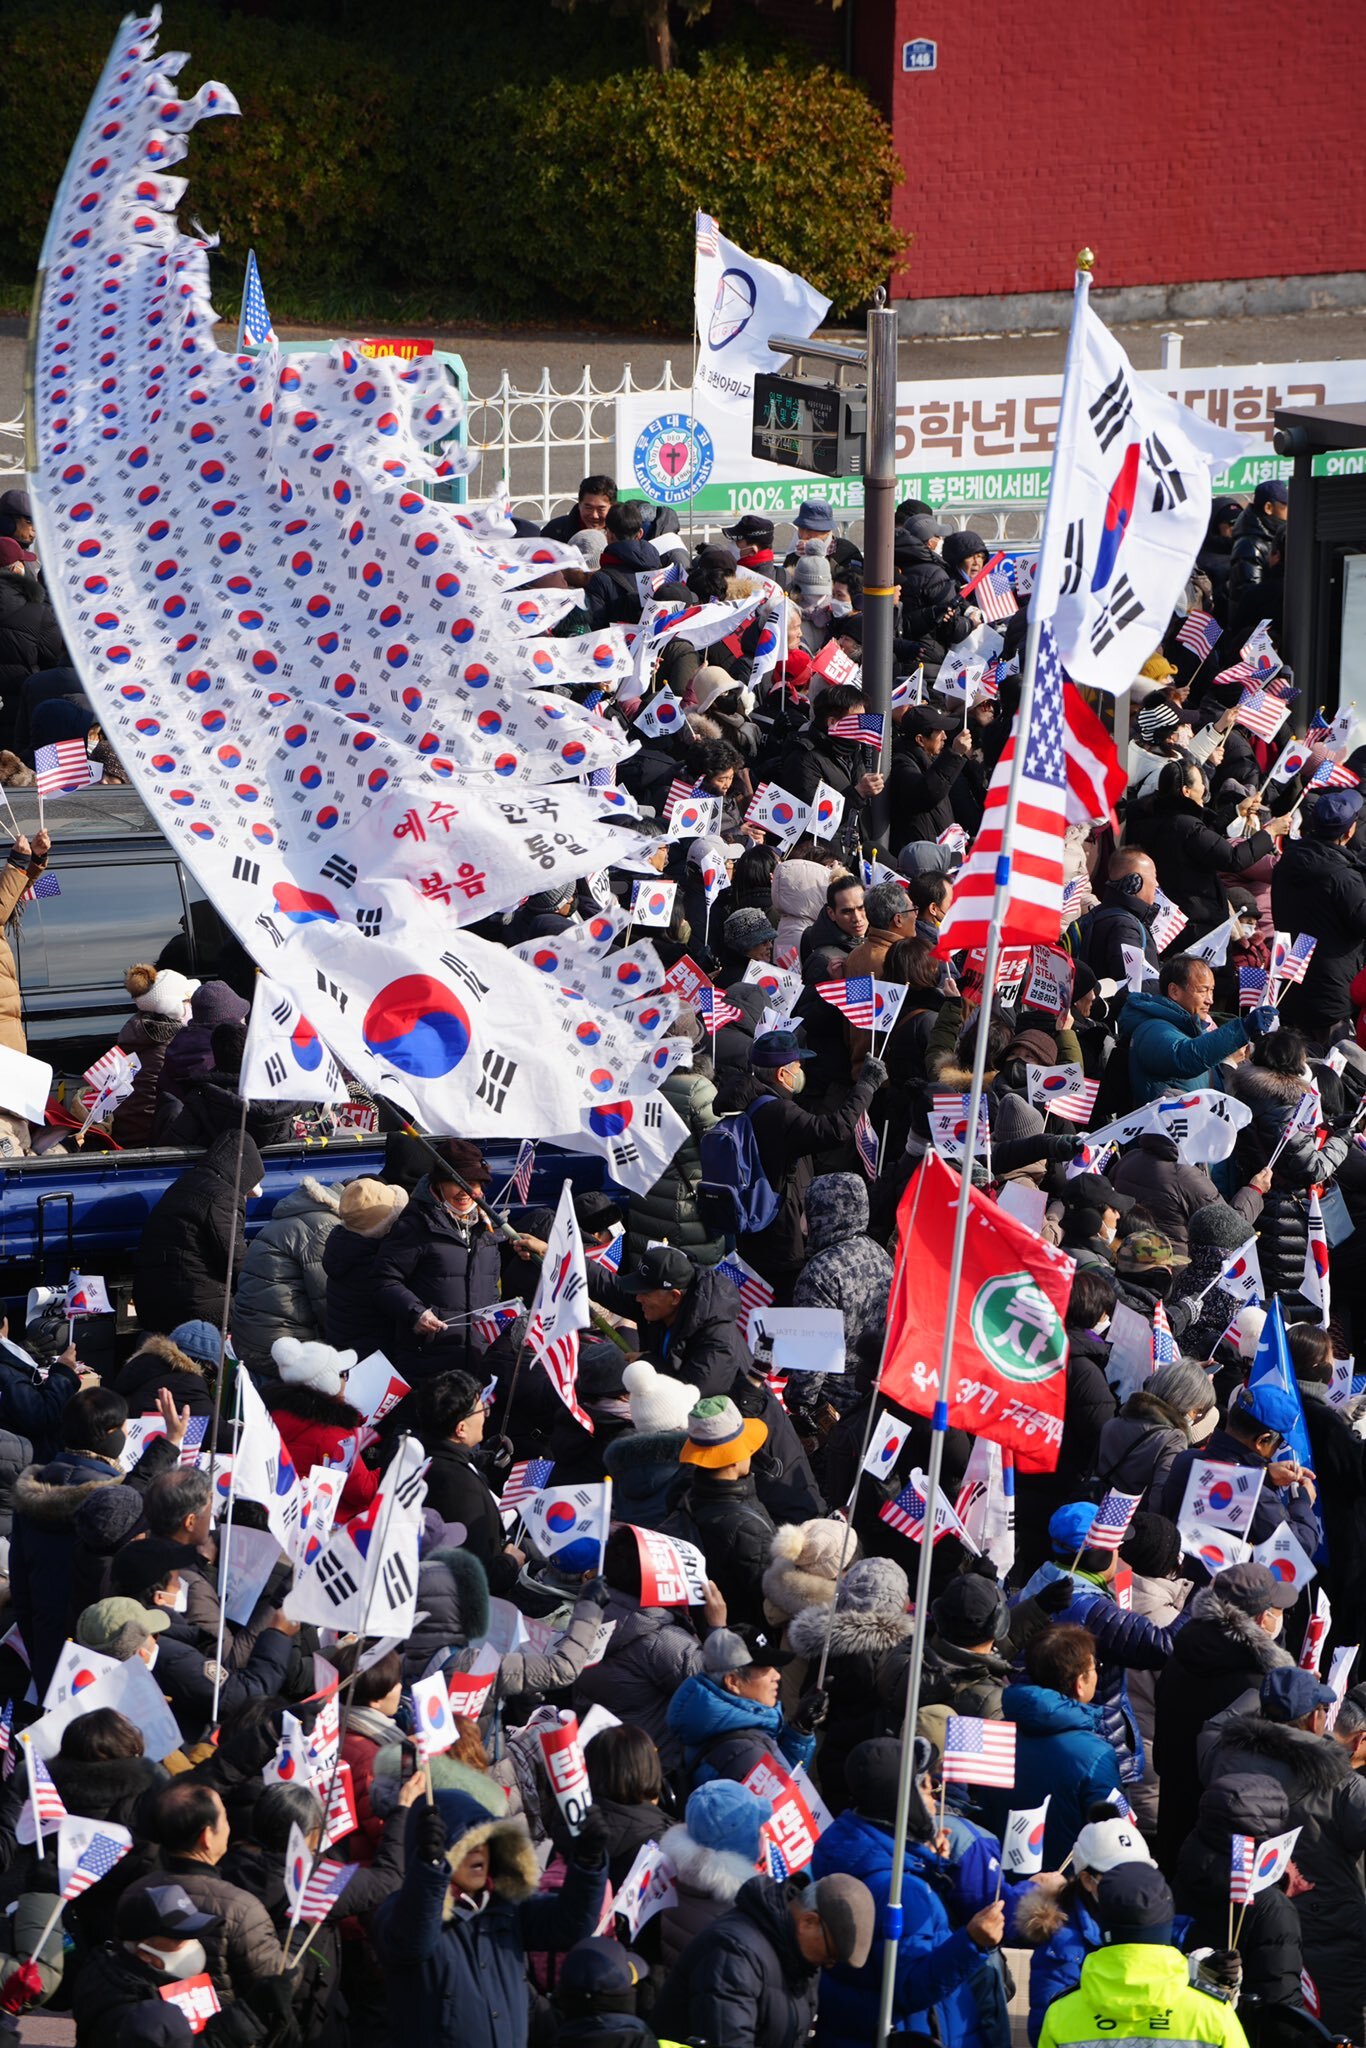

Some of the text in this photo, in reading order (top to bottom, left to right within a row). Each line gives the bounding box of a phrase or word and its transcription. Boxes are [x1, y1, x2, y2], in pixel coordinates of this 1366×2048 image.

[634, 457, 713, 503] Luther University
[728, 487, 785, 511] 100%
[1240, 459, 1315, 487] 사회복
[392, 801, 459, 843] 예수
[409, 831, 589, 907] 복음 통일
[1034, 944, 1051, 960] STOP
[1036, 954, 1048, 968] THE
[1035, 965, 1058, 984] STEAL
[1033, 978, 1058, 995] 부정선거
[1029, 989, 1058, 1007] 검증하라
